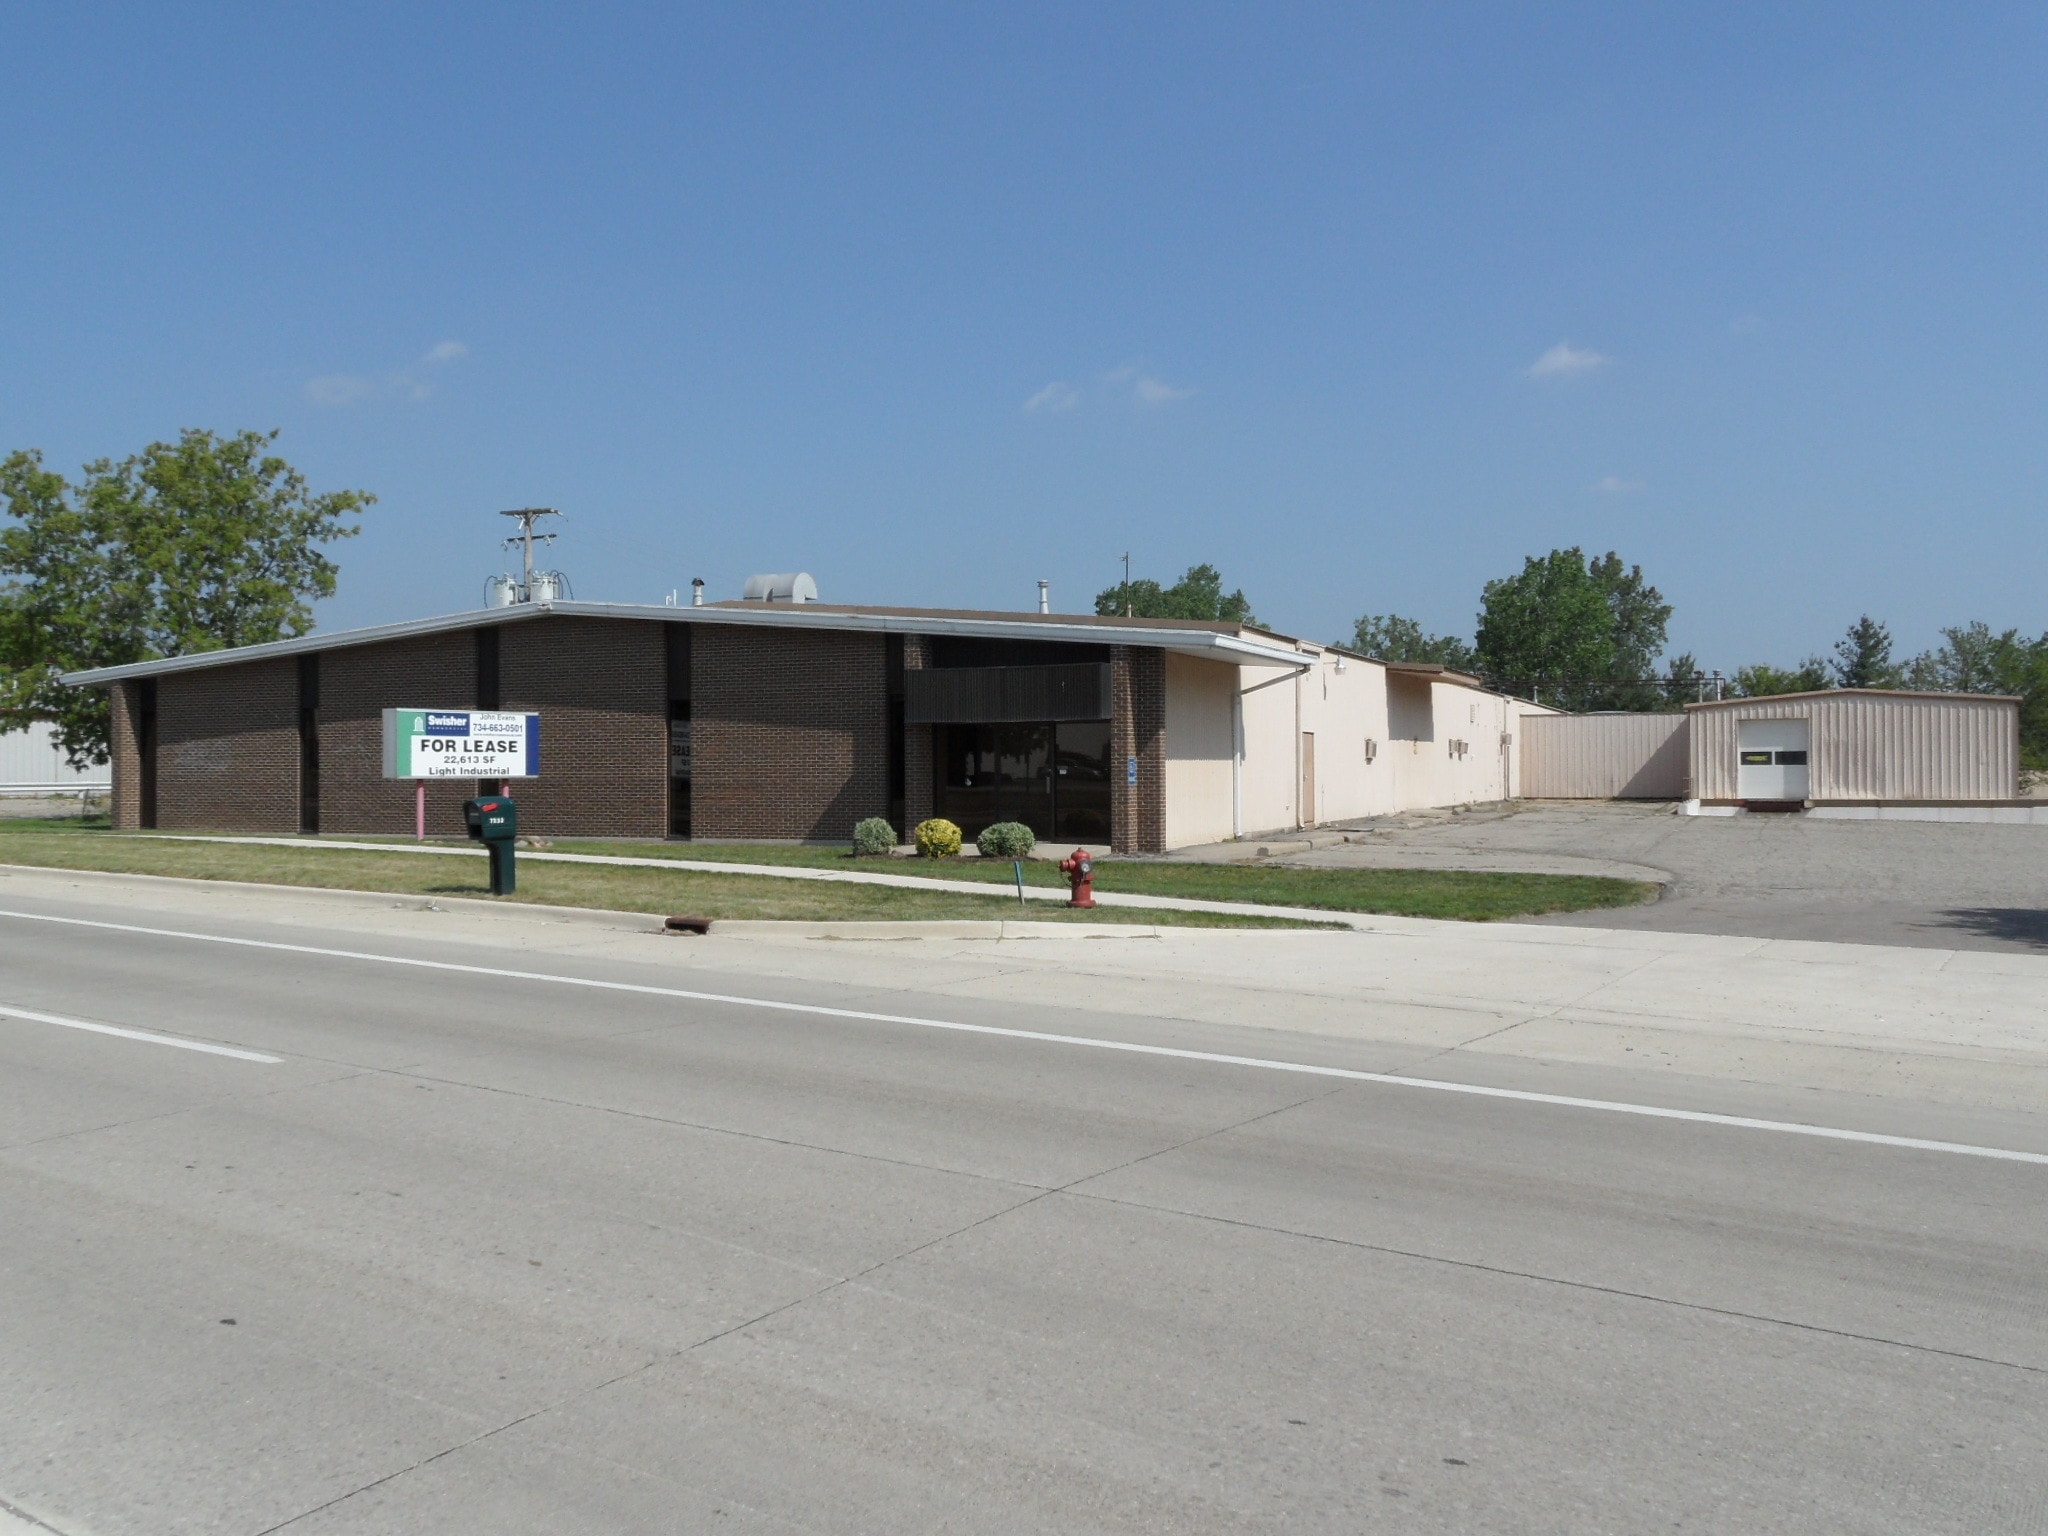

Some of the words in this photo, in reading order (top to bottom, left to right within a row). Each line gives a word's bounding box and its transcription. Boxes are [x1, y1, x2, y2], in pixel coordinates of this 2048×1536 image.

[428, 715, 467, 726] Swisher
[473, 723, 523, 733] 734-663-0501
[421, 739, 456, 753] FOR
[463, 740, 518, 753] LEASE
[444, 756, 480, 764] 22,613
[482, 756, 496, 764] SF
[429, 767, 456, 776] Light
[460, 767, 510, 775] Industrial
